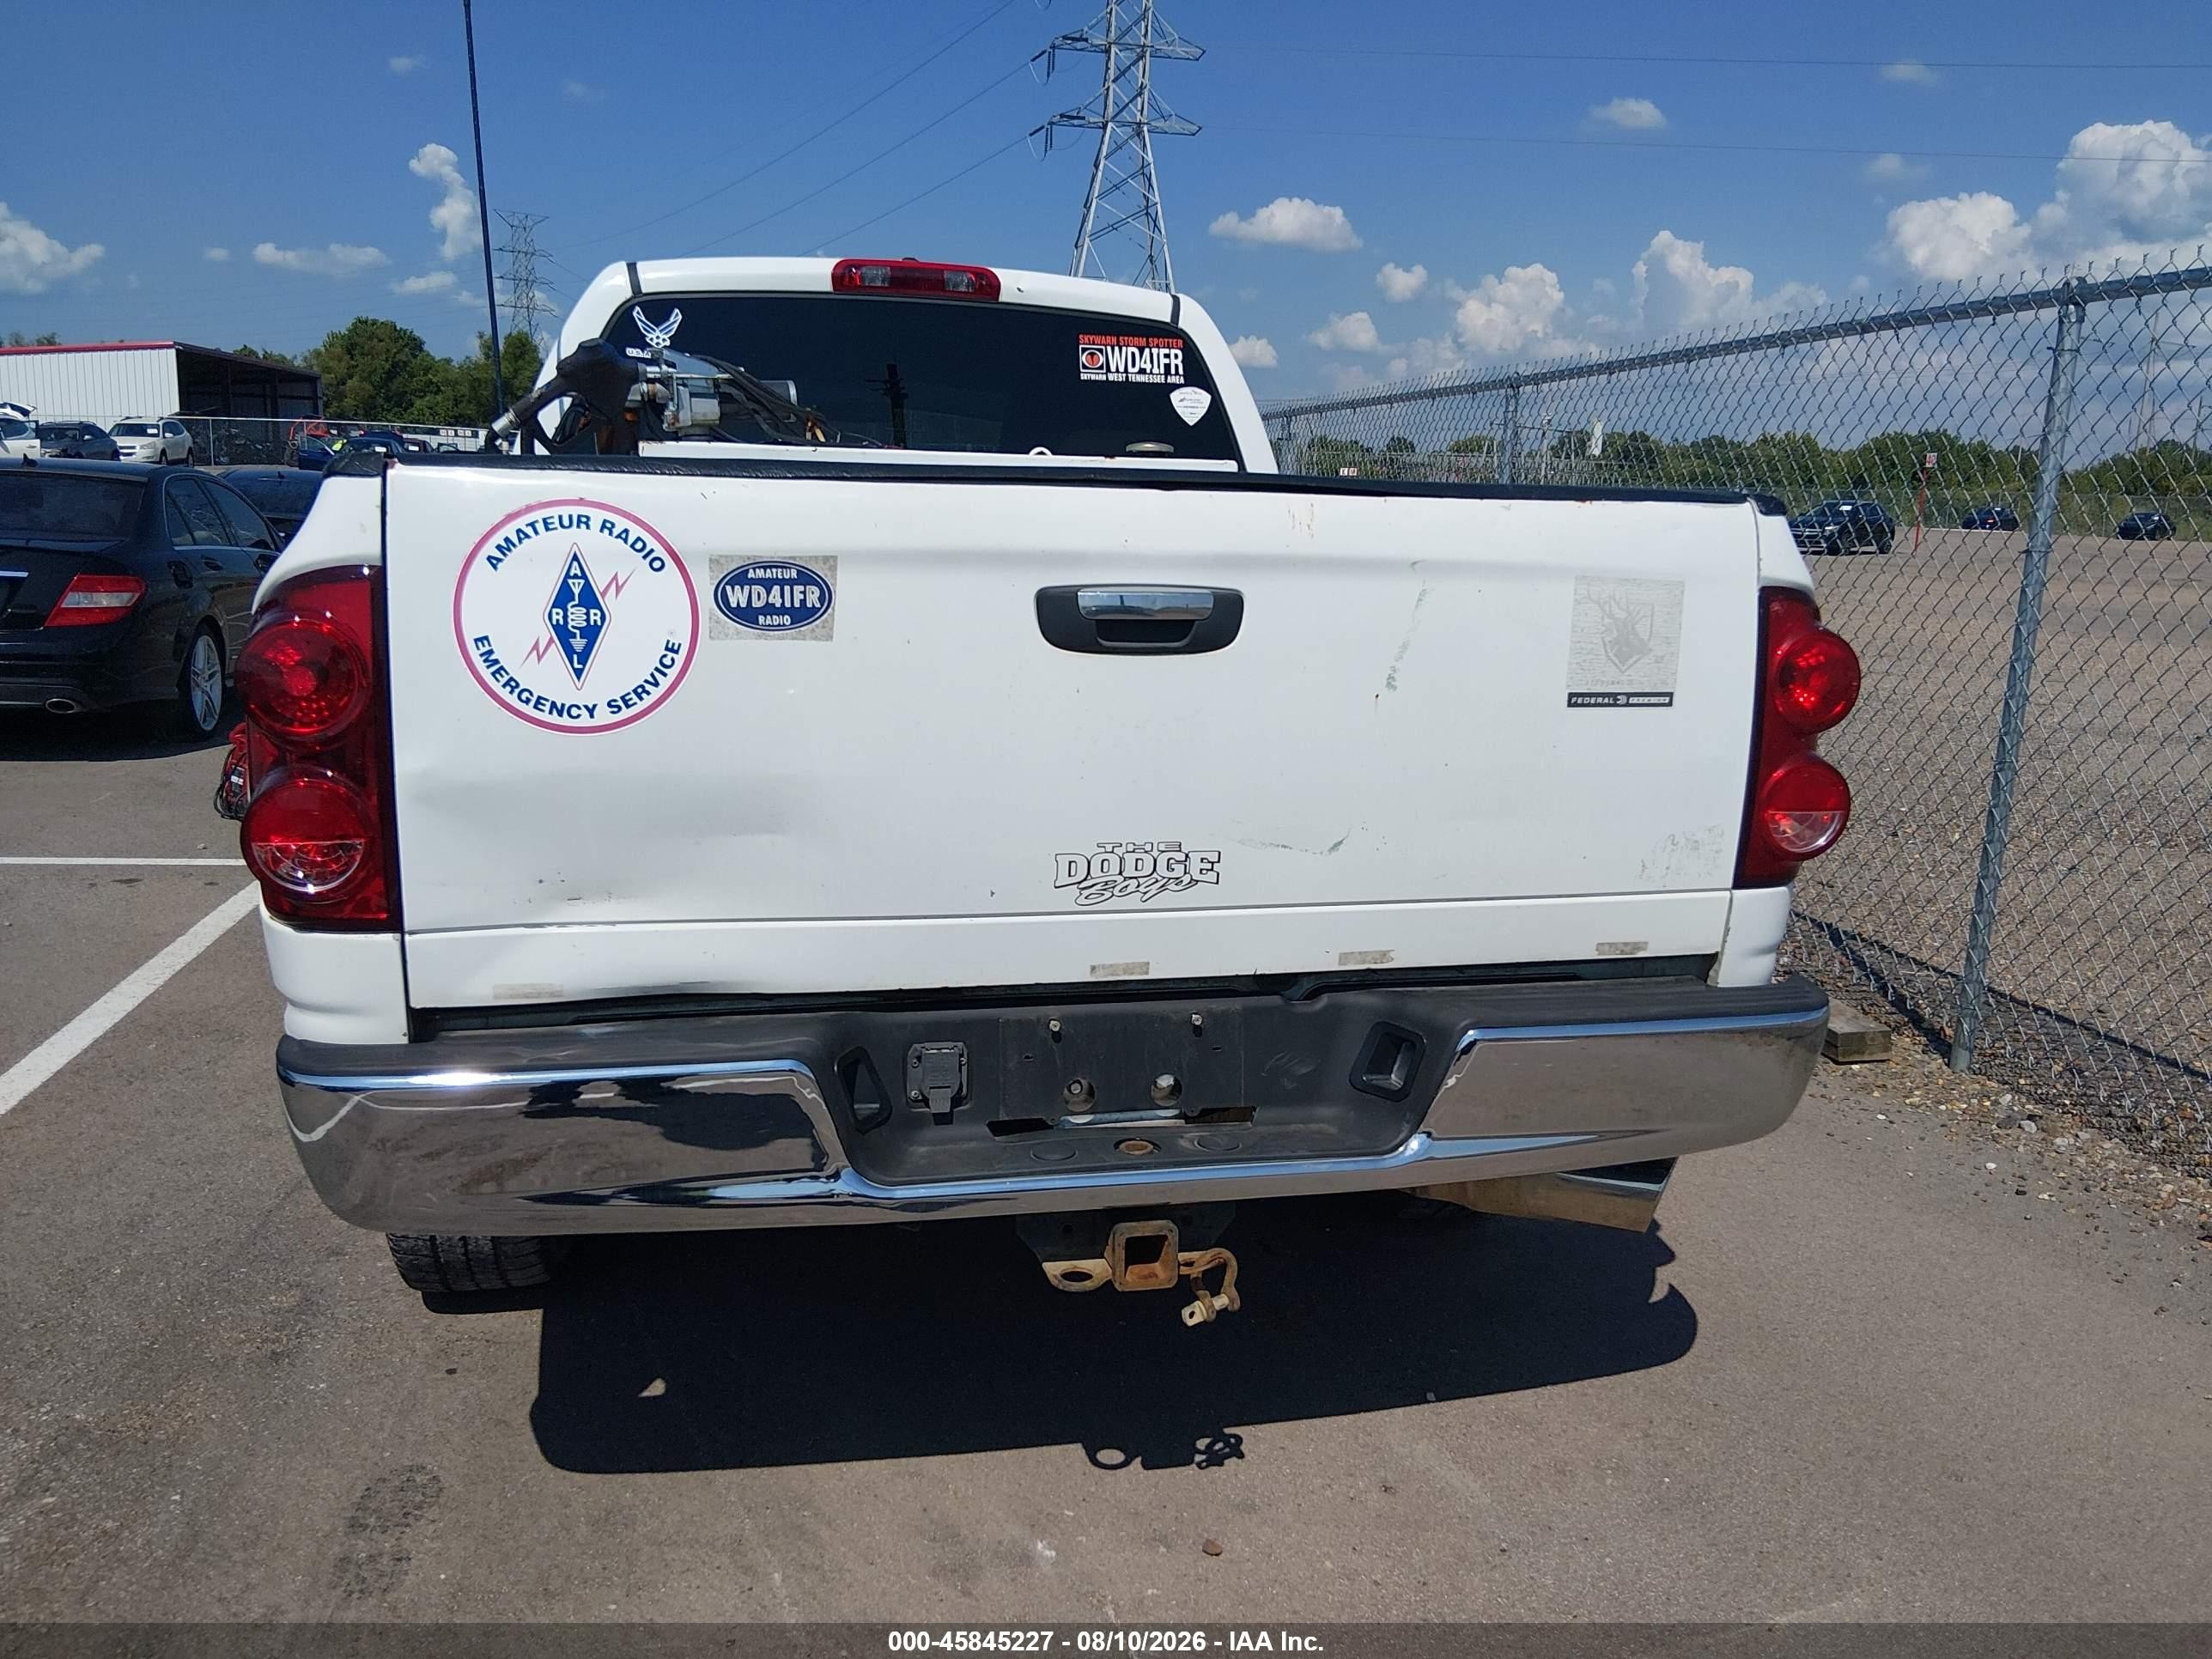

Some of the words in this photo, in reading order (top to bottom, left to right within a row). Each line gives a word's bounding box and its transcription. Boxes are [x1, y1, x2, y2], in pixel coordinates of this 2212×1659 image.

[1079, 334, 1117, 346] SKYWARN
[1119, 336, 1147, 347] STORM
[1148, 338, 1183, 349] SPOTTER
[1106, 345, 1184, 375] WD4IFR
[1107, 373, 1127, 382] WEST
[1127, 374, 1165, 383] TENNESSEE
[1166, 375, 1185, 385] AREA
[485, 514, 592, 572] AMATEUR
[599, 518, 666, 573] RADIO
[747, 568, 798, 579] AMATEUR
[725, 585, 822, 608] WD4IFR
[758, 615, 791, 626] RADIO
[472, 635, 598, 720] EMERGENCY
[606, 639, 682, 715] SERVICE
[1097, 842, 1182, 853] THE
[1054, 850, 1221, 889] DODGE
[1074, 872, 1199, 907] Boys
